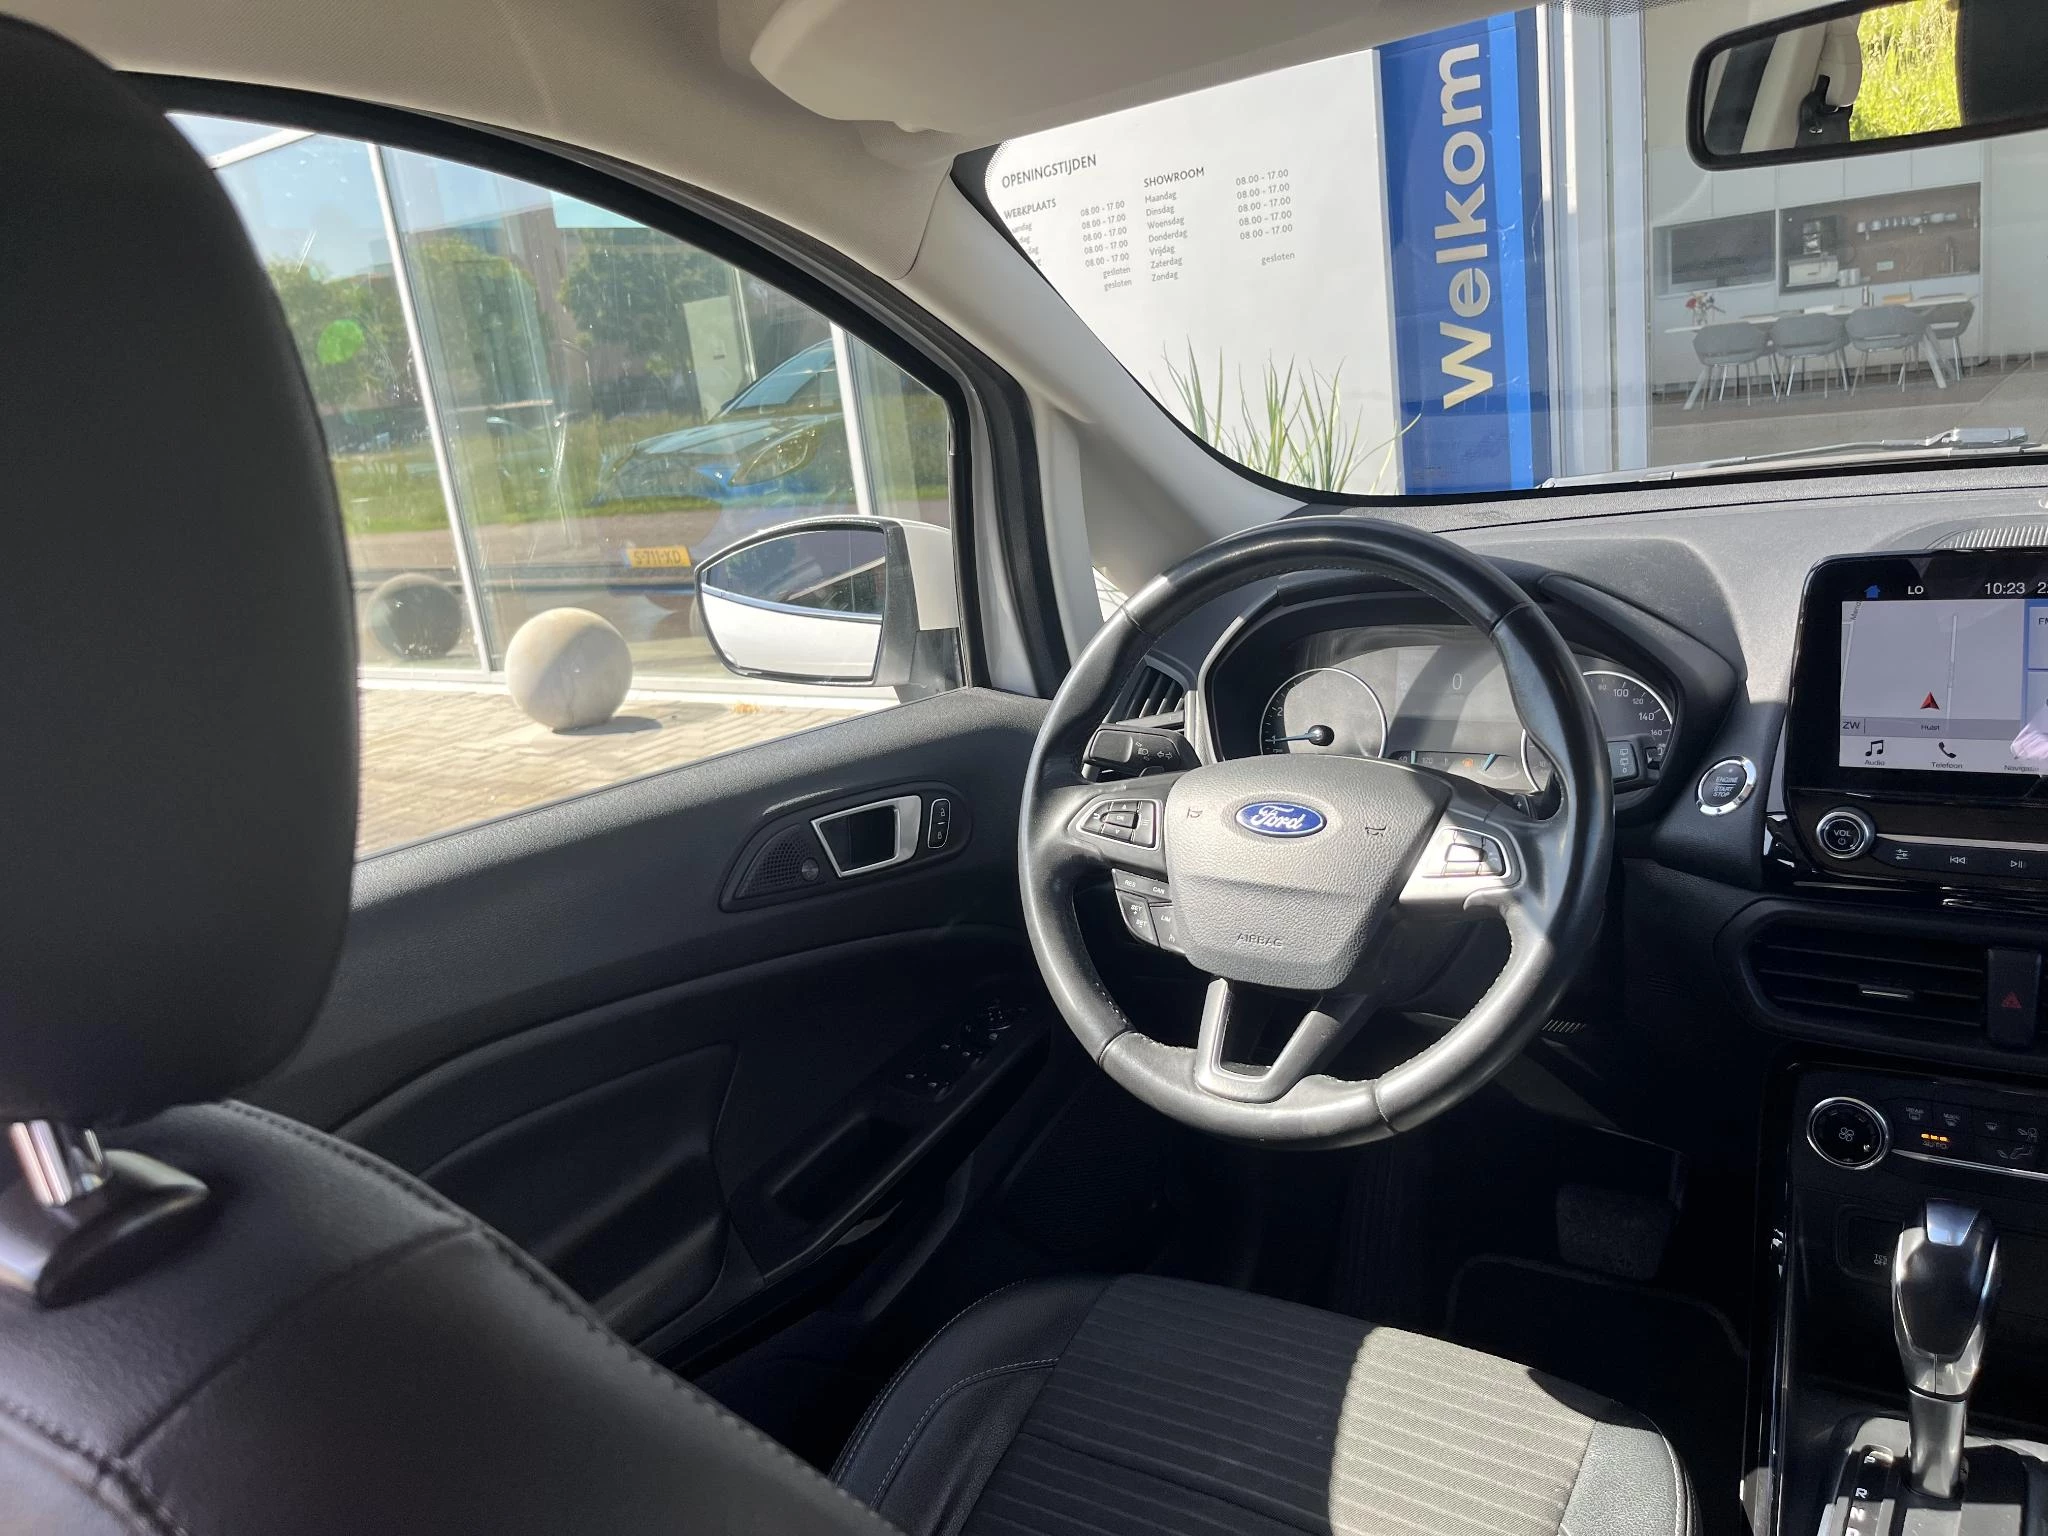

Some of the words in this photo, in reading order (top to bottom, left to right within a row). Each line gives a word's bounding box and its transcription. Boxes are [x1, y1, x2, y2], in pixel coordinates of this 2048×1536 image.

[1001, 154, 1097, 189] OPENINGSTIJDEN
[1143, 167, 1205, 188] SHOWROOM
[1236, 174, 1259, 186] 08.00
[1267, 169, 1289, 181] 17.00
[1145, 191, 1177, 203] Maandag
[1236, 188, 1260, 200] 08.00
[1268, 182, 1290, 194] 17.00
[1003, 198, 1057, 220] WERKPLAATS
[1145, 205, 1175, 217] Dinsdag
[1237, 201, 1261, 213] 08.00
[1269, 196, 1291, 208] 17.00
[1147, 216, 1185, 230] Woensdag
[1238, 215, 1262, 227] 08.00
[1270, 210, 1292, 222] 17.00
[1239, 228, 1263, 240] 08.00
[1271, 223, 1293, 236] 17.00
[1435, 43, 1494, 410] Welkom
[1148, 229, 1188, 243] Donderdag
[1149, 244, 1176, 257] Vrijdag
[1150, 257, 1183, 270] Zaterdag
[1261, 252, 1295, 266] gesloten
[1151, 271, 1178, 282] Zondag
[1907, 585, 1924, 595] LO
[1984, 582, 2026, 595] 10:23
[1613, 688, 1629, 697] 100
[1638, 712, 1655, 721] 140
[1842, 721, 1861, 730] ZW
[1250, 805, 1307, 830] Ford
[1833, 829, 1851, 837] VOL
[1152, 886, 1165, 895] CAN
[1130, 904, 1142, 912] SET
[1236, 933, 1283, 947] AIRBAG
[1863, 1455, 1876, 1464] P
[1854, 1487, 1868, 1499] R
[1849, 1506, 1865, 1521] N
